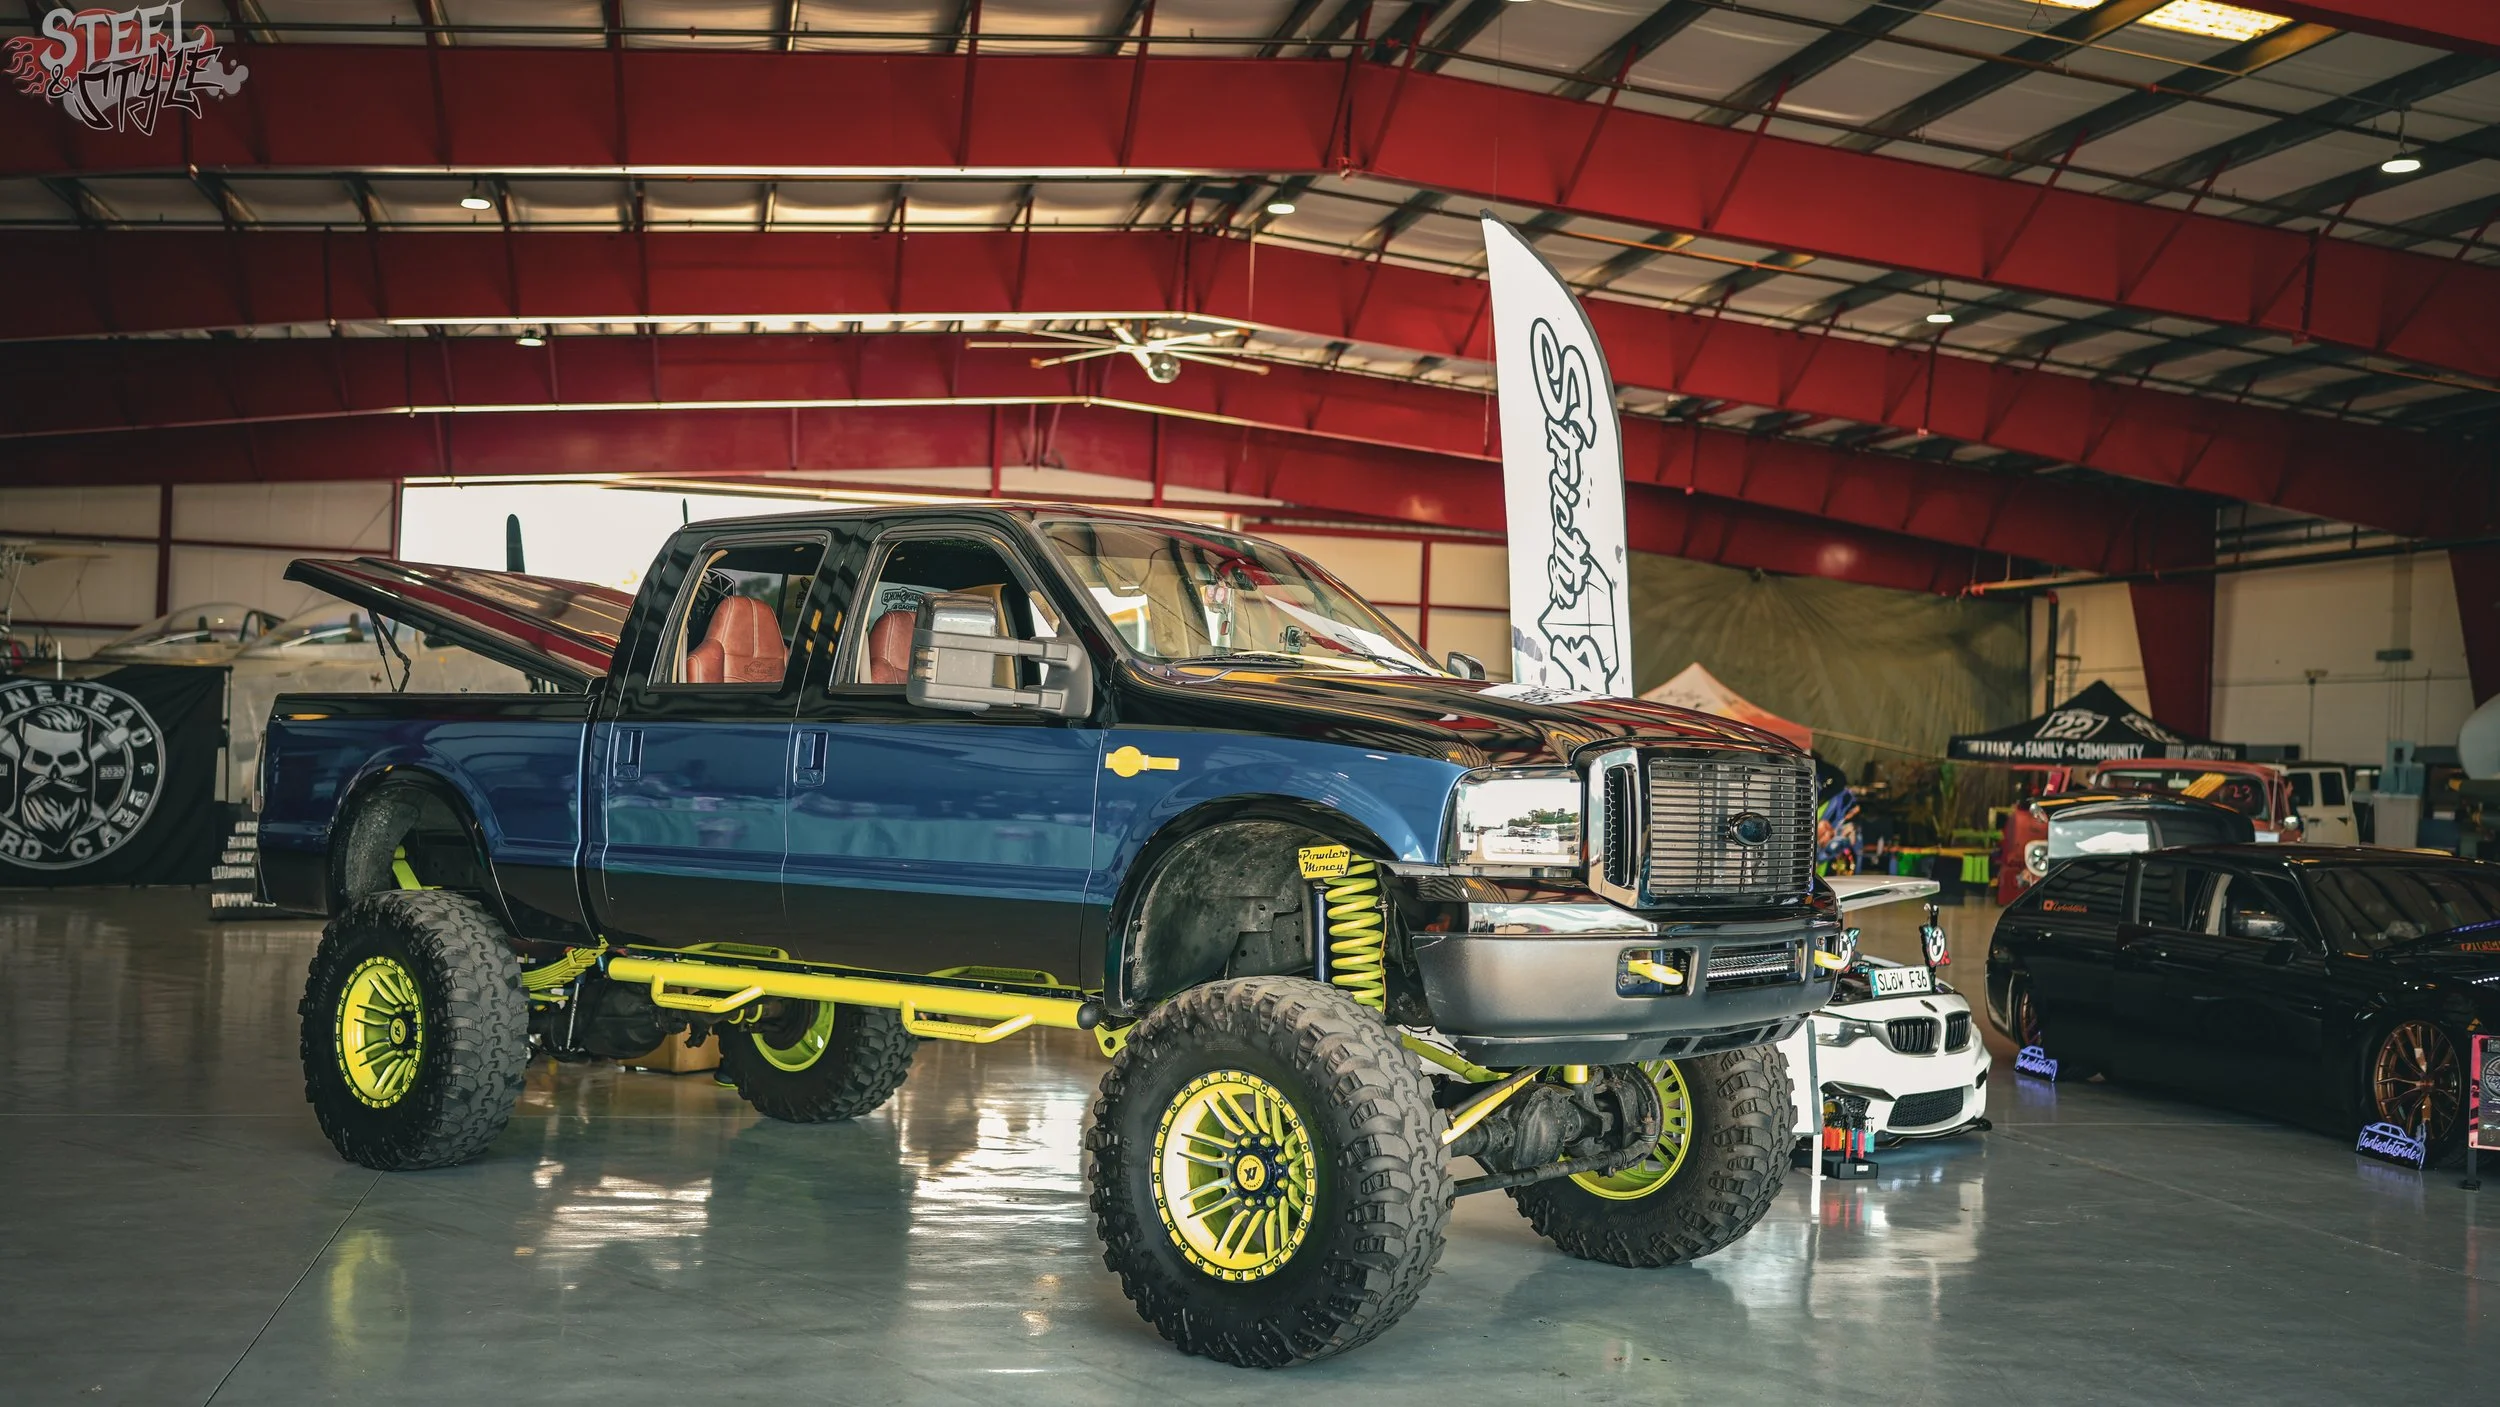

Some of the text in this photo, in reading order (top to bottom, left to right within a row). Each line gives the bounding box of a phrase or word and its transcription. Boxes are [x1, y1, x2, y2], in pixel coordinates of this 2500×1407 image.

[0, 686, 153, 748] NEHEAD
[2045, 716, 2094, 739] 22
[2025, 741, 2064, 759] FAMILY
[2077, 742, 2145, 761] COMMUNITY
[100, 766, 125, 778] 2020
[1301, 849, 1347, 860] Powder
[1304, 862, 1344, 872] Money
[1909, 970, 1928, 988] F36
